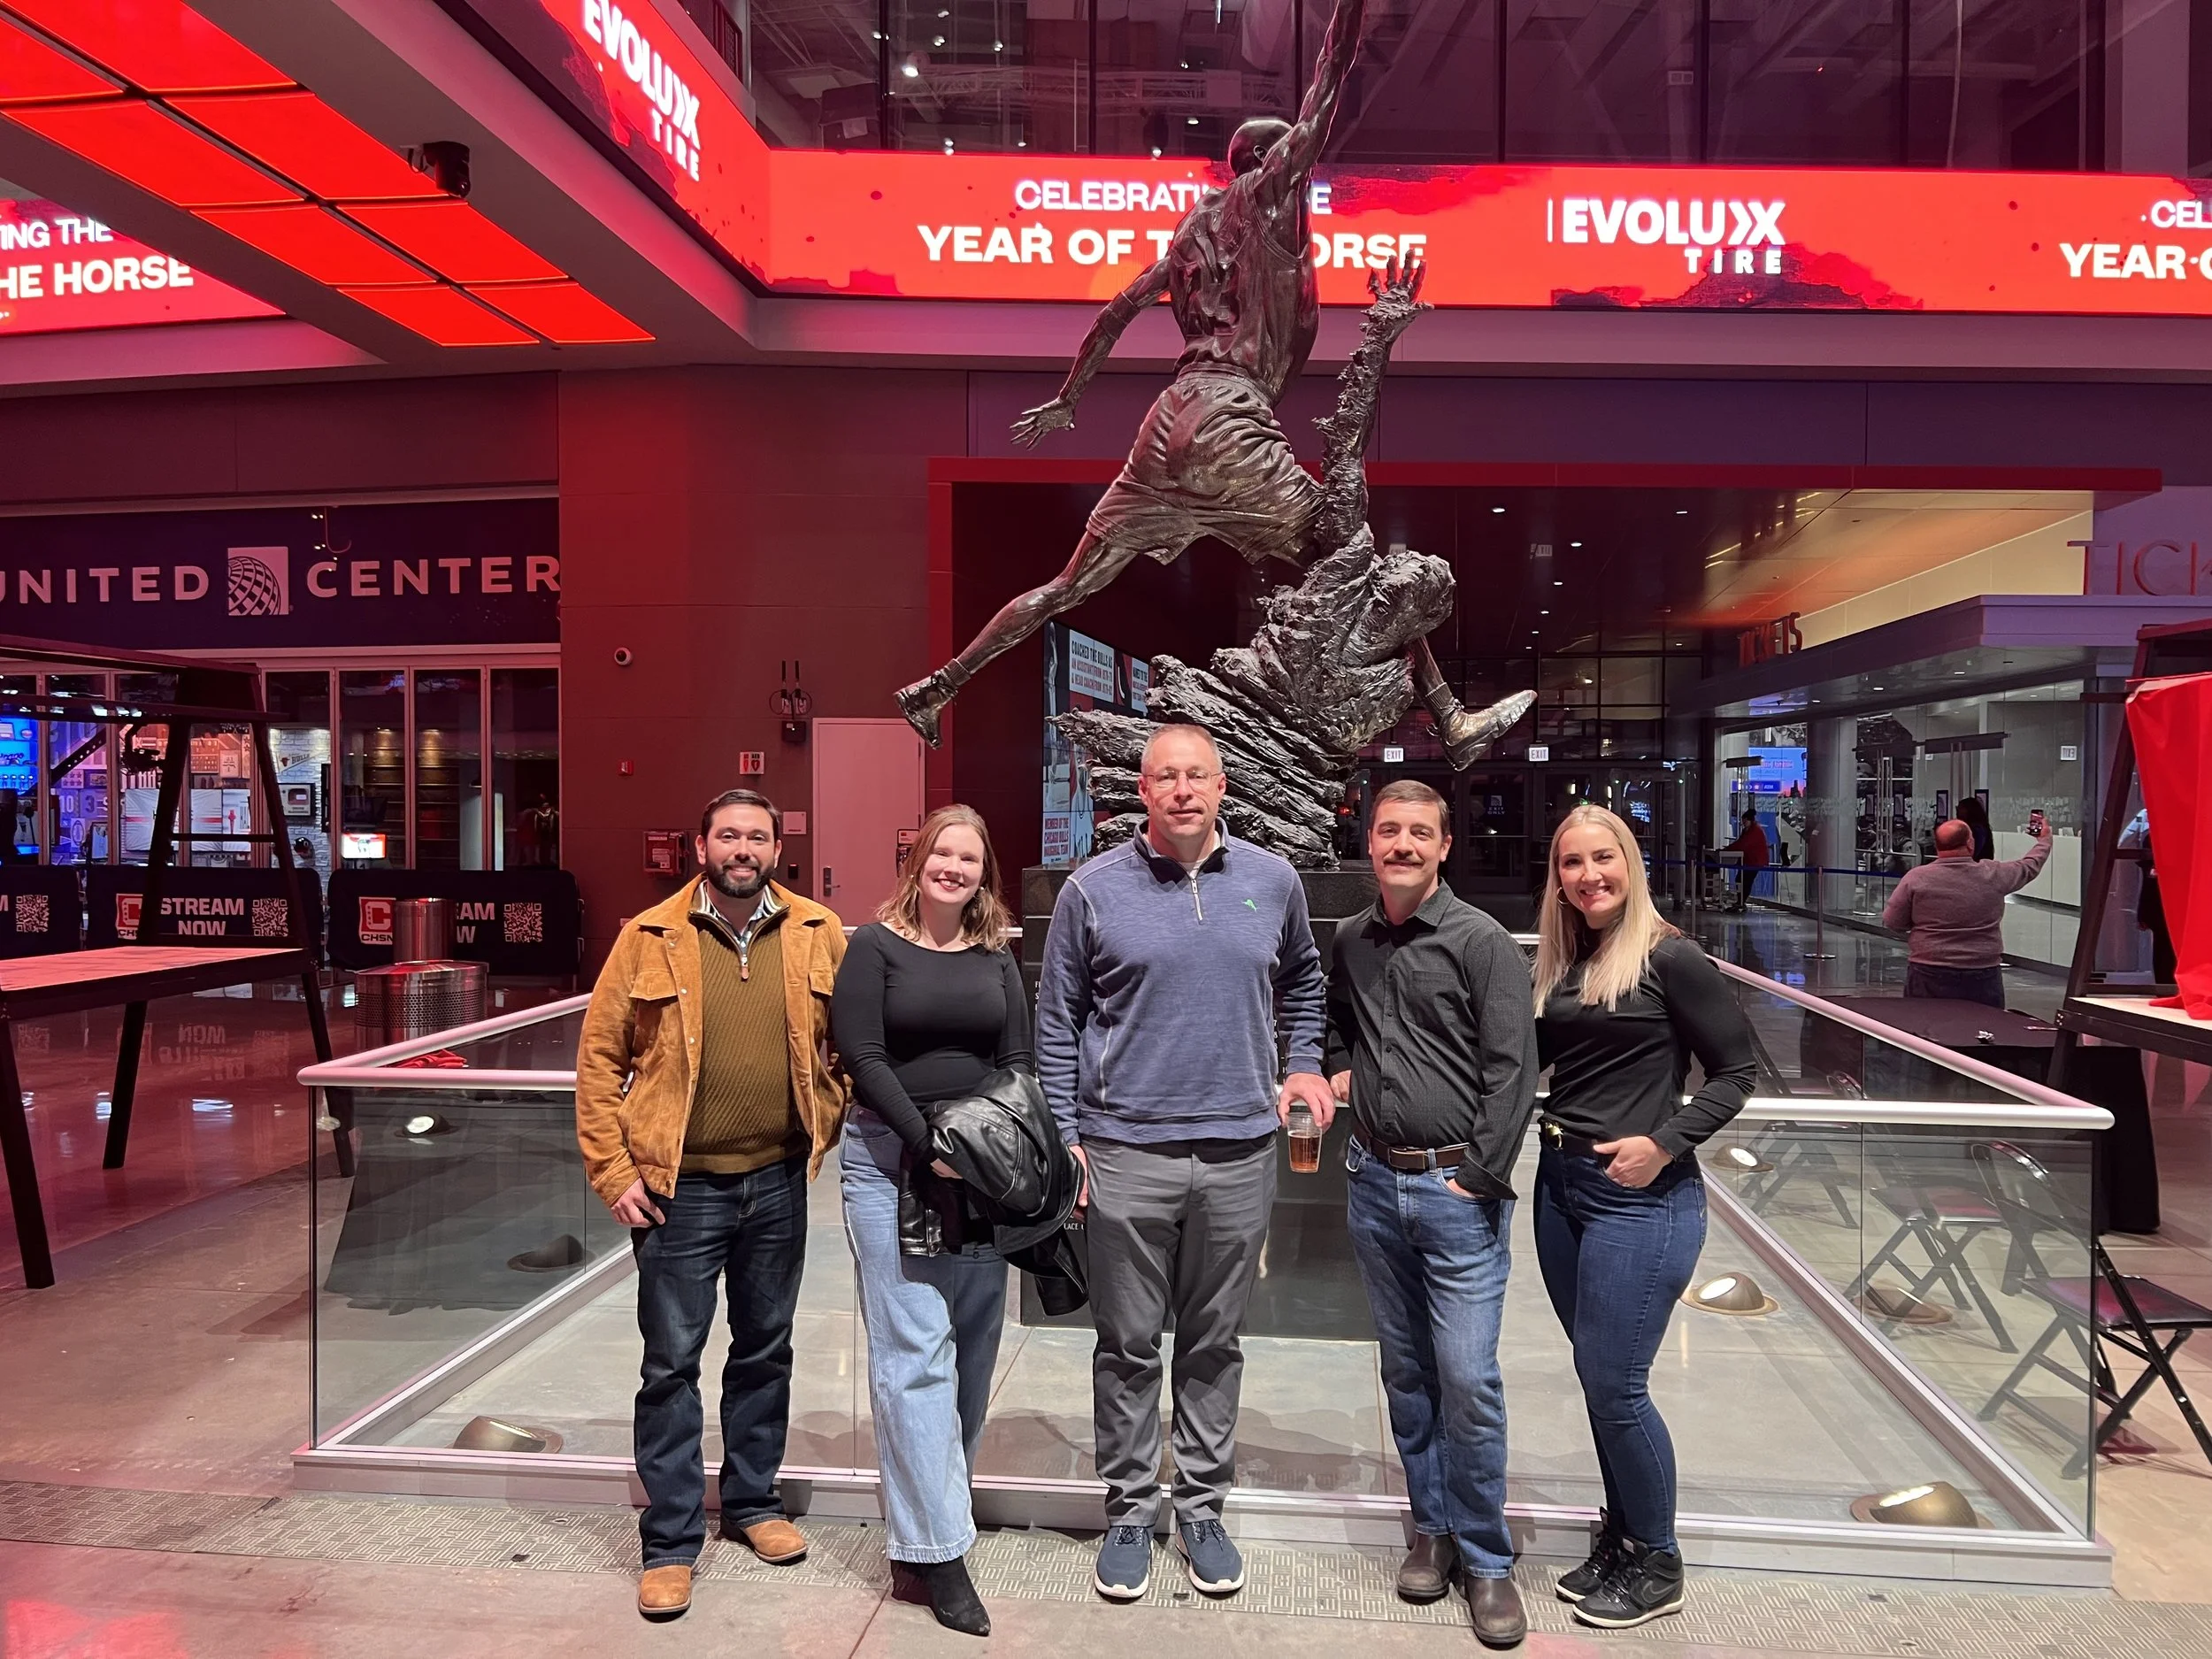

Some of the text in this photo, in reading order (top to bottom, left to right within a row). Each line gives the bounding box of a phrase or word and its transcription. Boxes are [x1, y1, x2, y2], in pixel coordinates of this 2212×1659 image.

[651, 108, 700, 181] TIRE
[1015, 180, 1210, 212] CELEBRATI
[0, 217, 113, 250] ING THE
[917, 224, 1054, 264] YEAR
[1068, 228, 1134, 265] OF
[1313, 233, 1426, 269] ORSE
[1684, 247, 1782, 274] TIRE
[2059, 242, 2186, 280] YEAR
[54, 254, 194, 296] HORSE
[0, 556, 560, 603] NITED CENTER
[1386, 749, 1402, 760] EXIT
[1531, 749, 1547, 759] EXIT
[160, 898, 244, 915] STREAM
[178, 920, 227, 936] NOW
